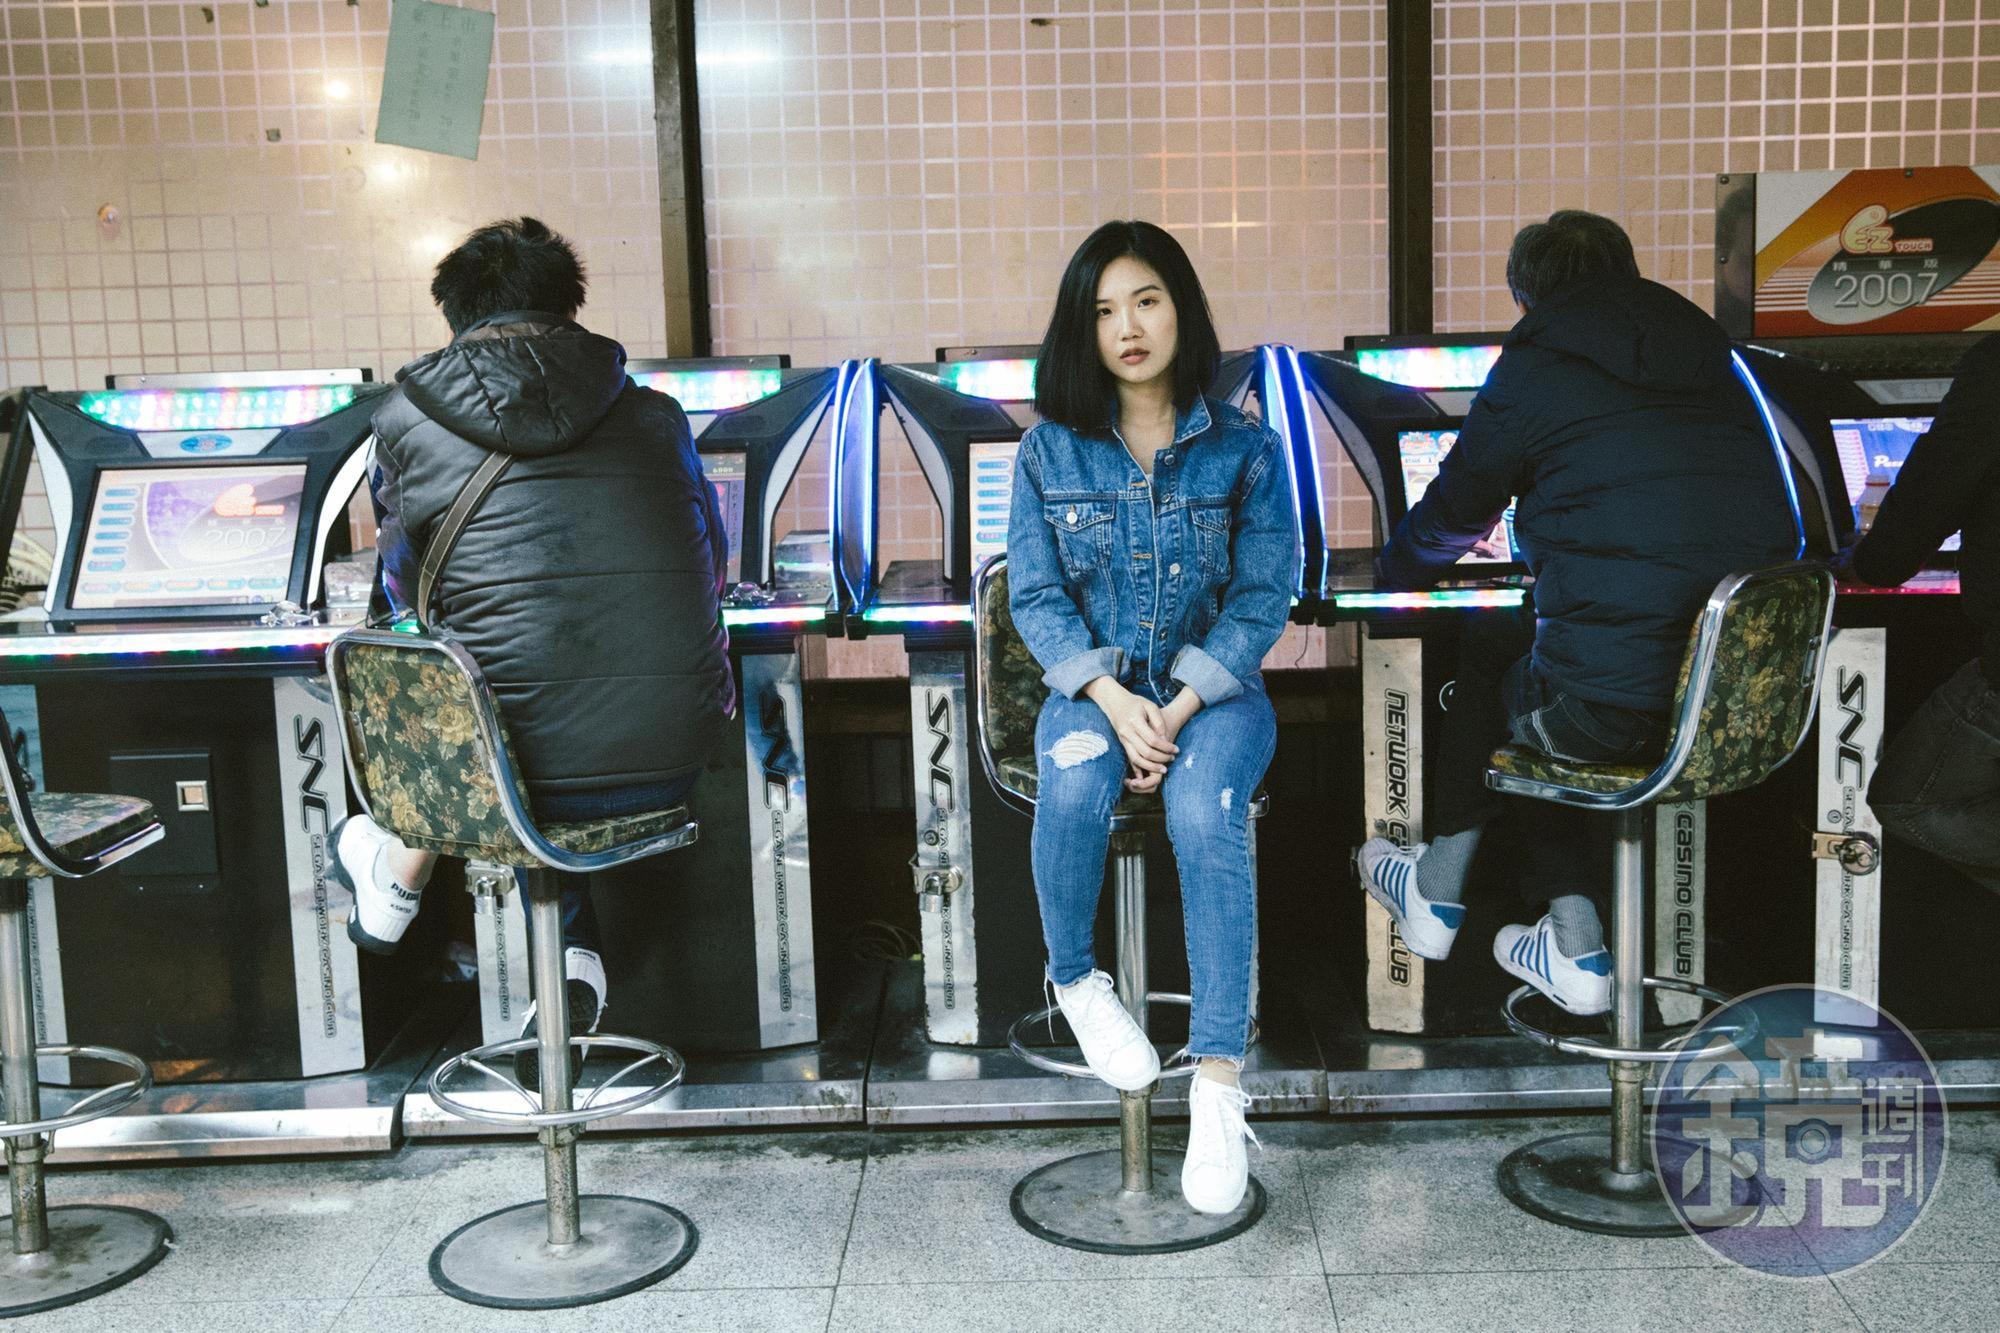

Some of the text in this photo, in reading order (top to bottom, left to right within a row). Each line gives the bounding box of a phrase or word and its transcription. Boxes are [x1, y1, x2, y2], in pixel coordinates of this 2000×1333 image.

[1896, 241, 1932, 252] TOUCH
[1834, 272, 1939, 308] 2007
[205, 527, 287, 548] 2007
[1676, 912, 1692, 975] CLUB
